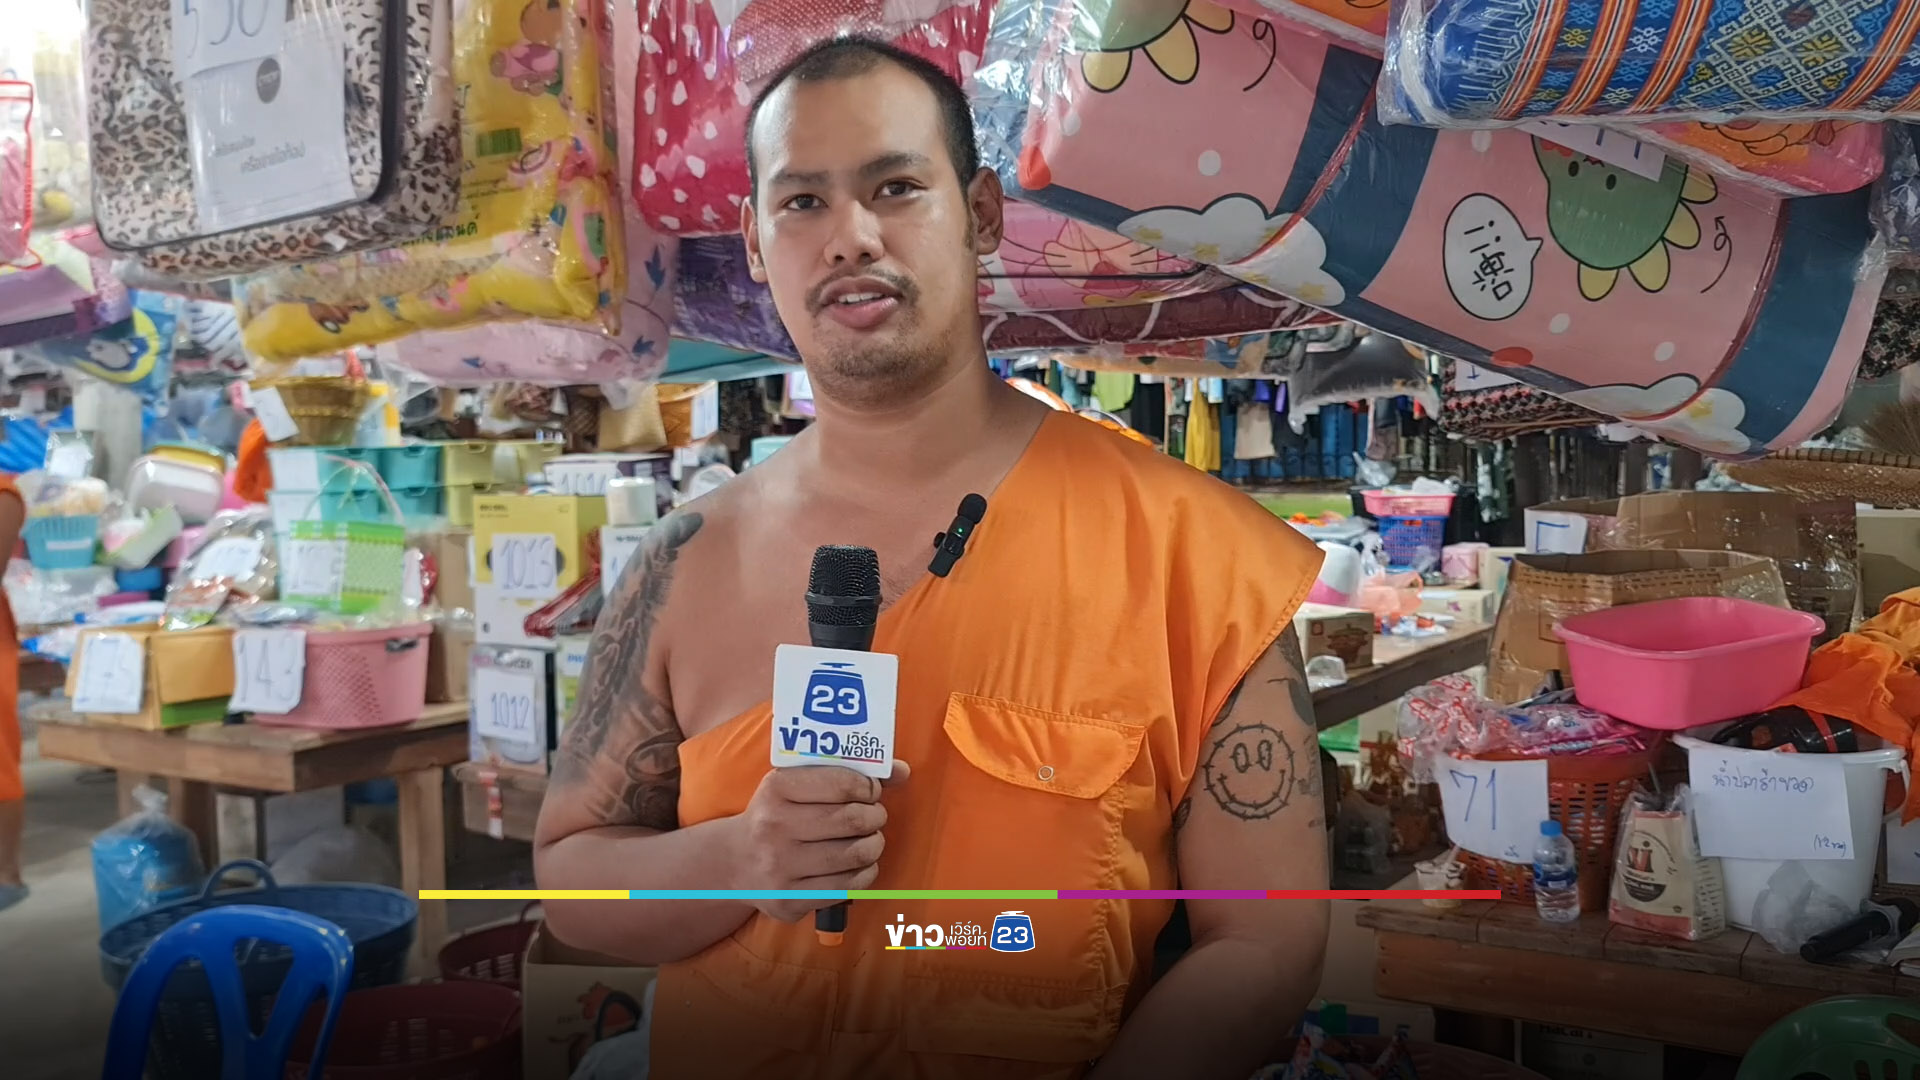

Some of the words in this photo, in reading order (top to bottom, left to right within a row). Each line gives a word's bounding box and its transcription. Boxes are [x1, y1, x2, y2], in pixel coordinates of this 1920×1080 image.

[501, 537, 556, 589] 1013
[491, 691, 530, 729] 1012
[810, 684, 861, 715] 23
[779, 716, 841, 755] ข่าว
[840, 744, 885, 759] พอยท์
[1449, 768, 1497, 830] 71
